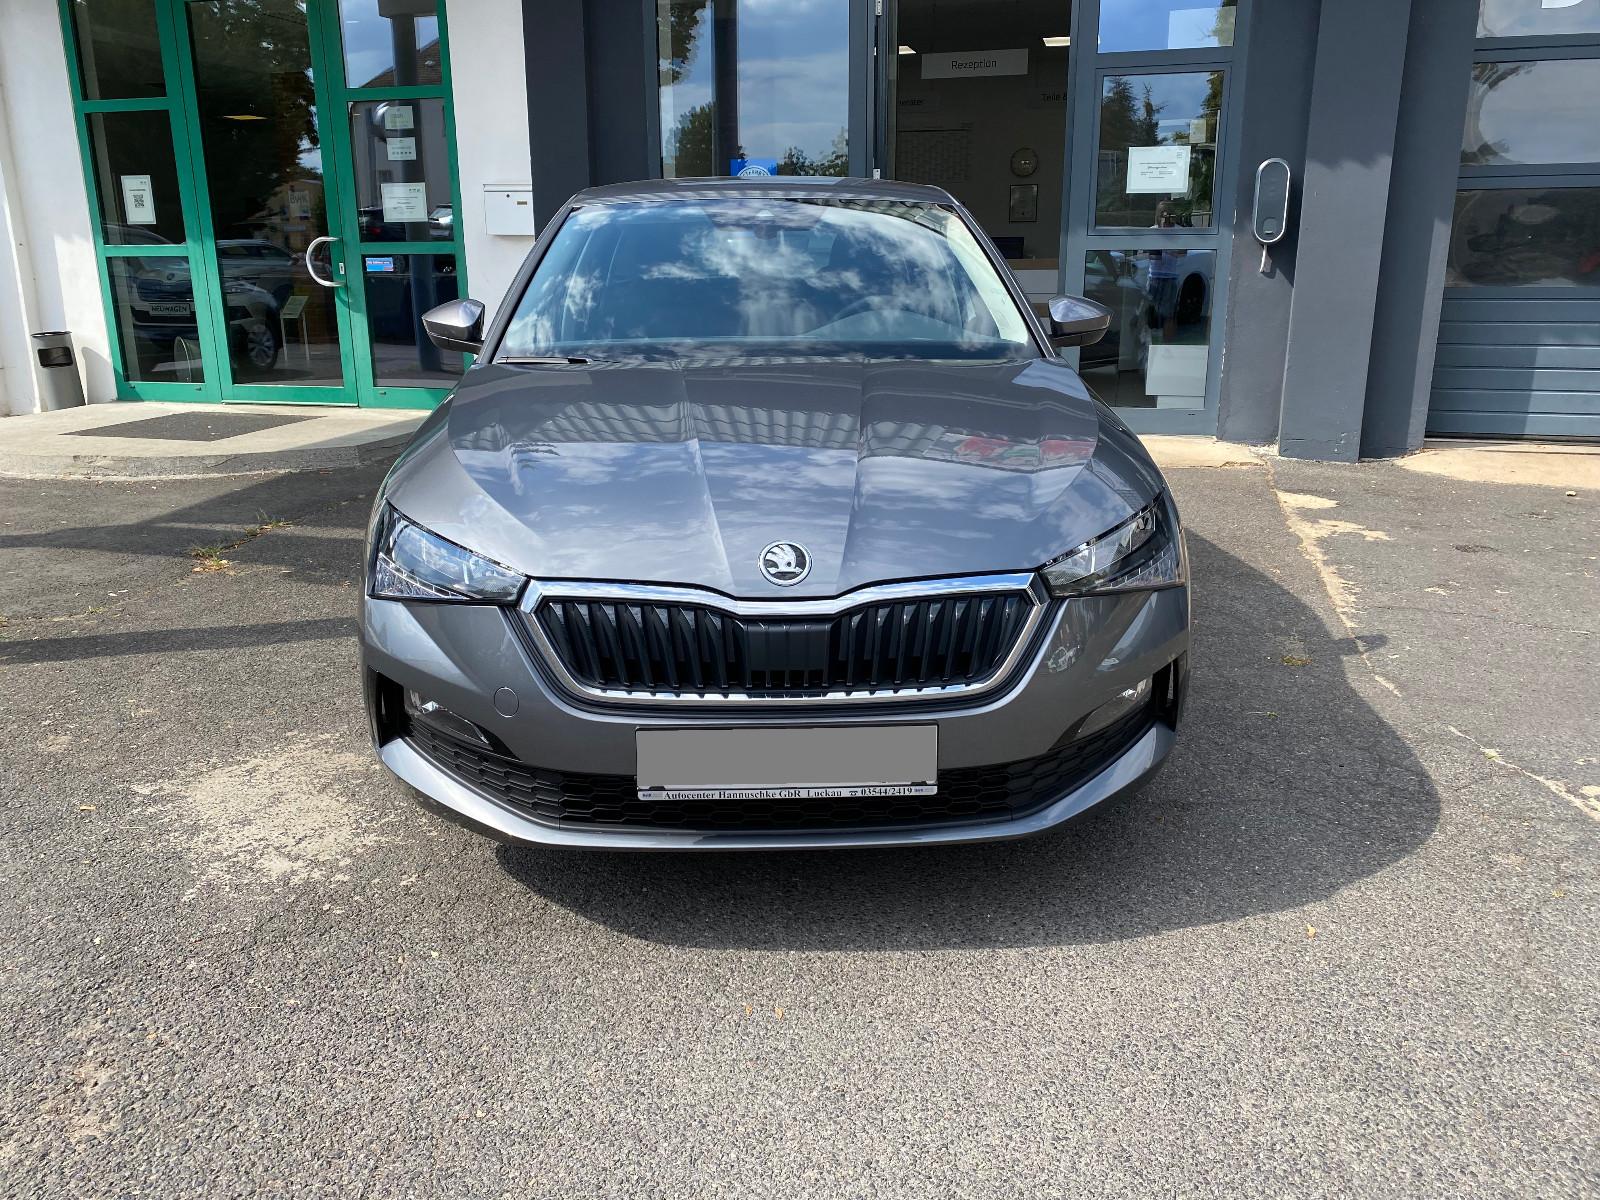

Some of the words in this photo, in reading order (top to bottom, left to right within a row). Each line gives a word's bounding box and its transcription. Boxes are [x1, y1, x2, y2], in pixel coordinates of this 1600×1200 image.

[951, 59, 997, 70] Rezeption
[151, 305, 187, 313] NEUWAGEN
[663, 791, 715, 800] Autocenter
[719, 790, 777, 799] Hannuschke
[779, 789, 801, 798] GbR
[807, 788, 842, 797] Luckau
[861, 787, 912, 796] 03544/2419
